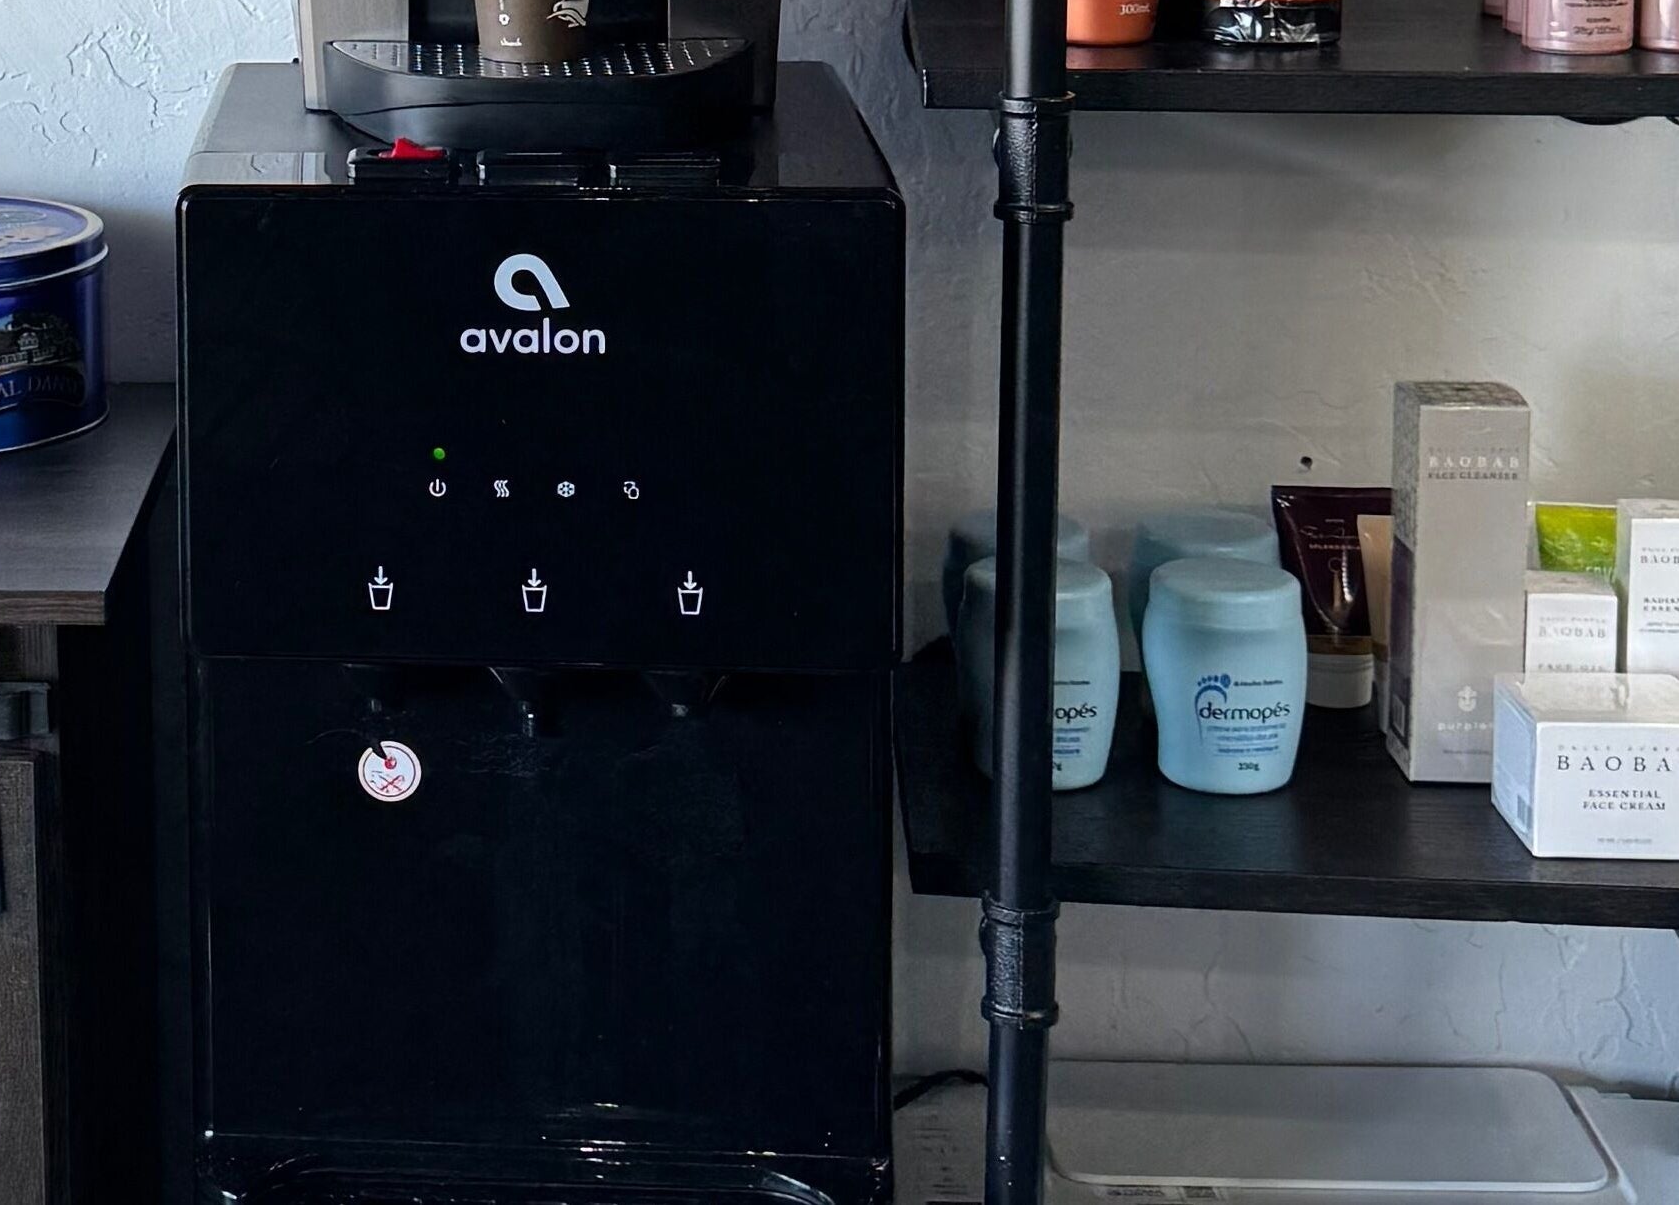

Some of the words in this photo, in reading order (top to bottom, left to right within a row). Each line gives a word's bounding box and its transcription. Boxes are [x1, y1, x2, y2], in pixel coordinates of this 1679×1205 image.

[459, 317, 607, 355] avalon
[1054, 703, 1098, 724] opés
[1199, 701, 1291, 724] dermopés
[1588, 788, 1662, 799] ESSENTIAL
[1582, 801, 1617, 810] FACE
[1619, 802, 1667, 811] CREAM
